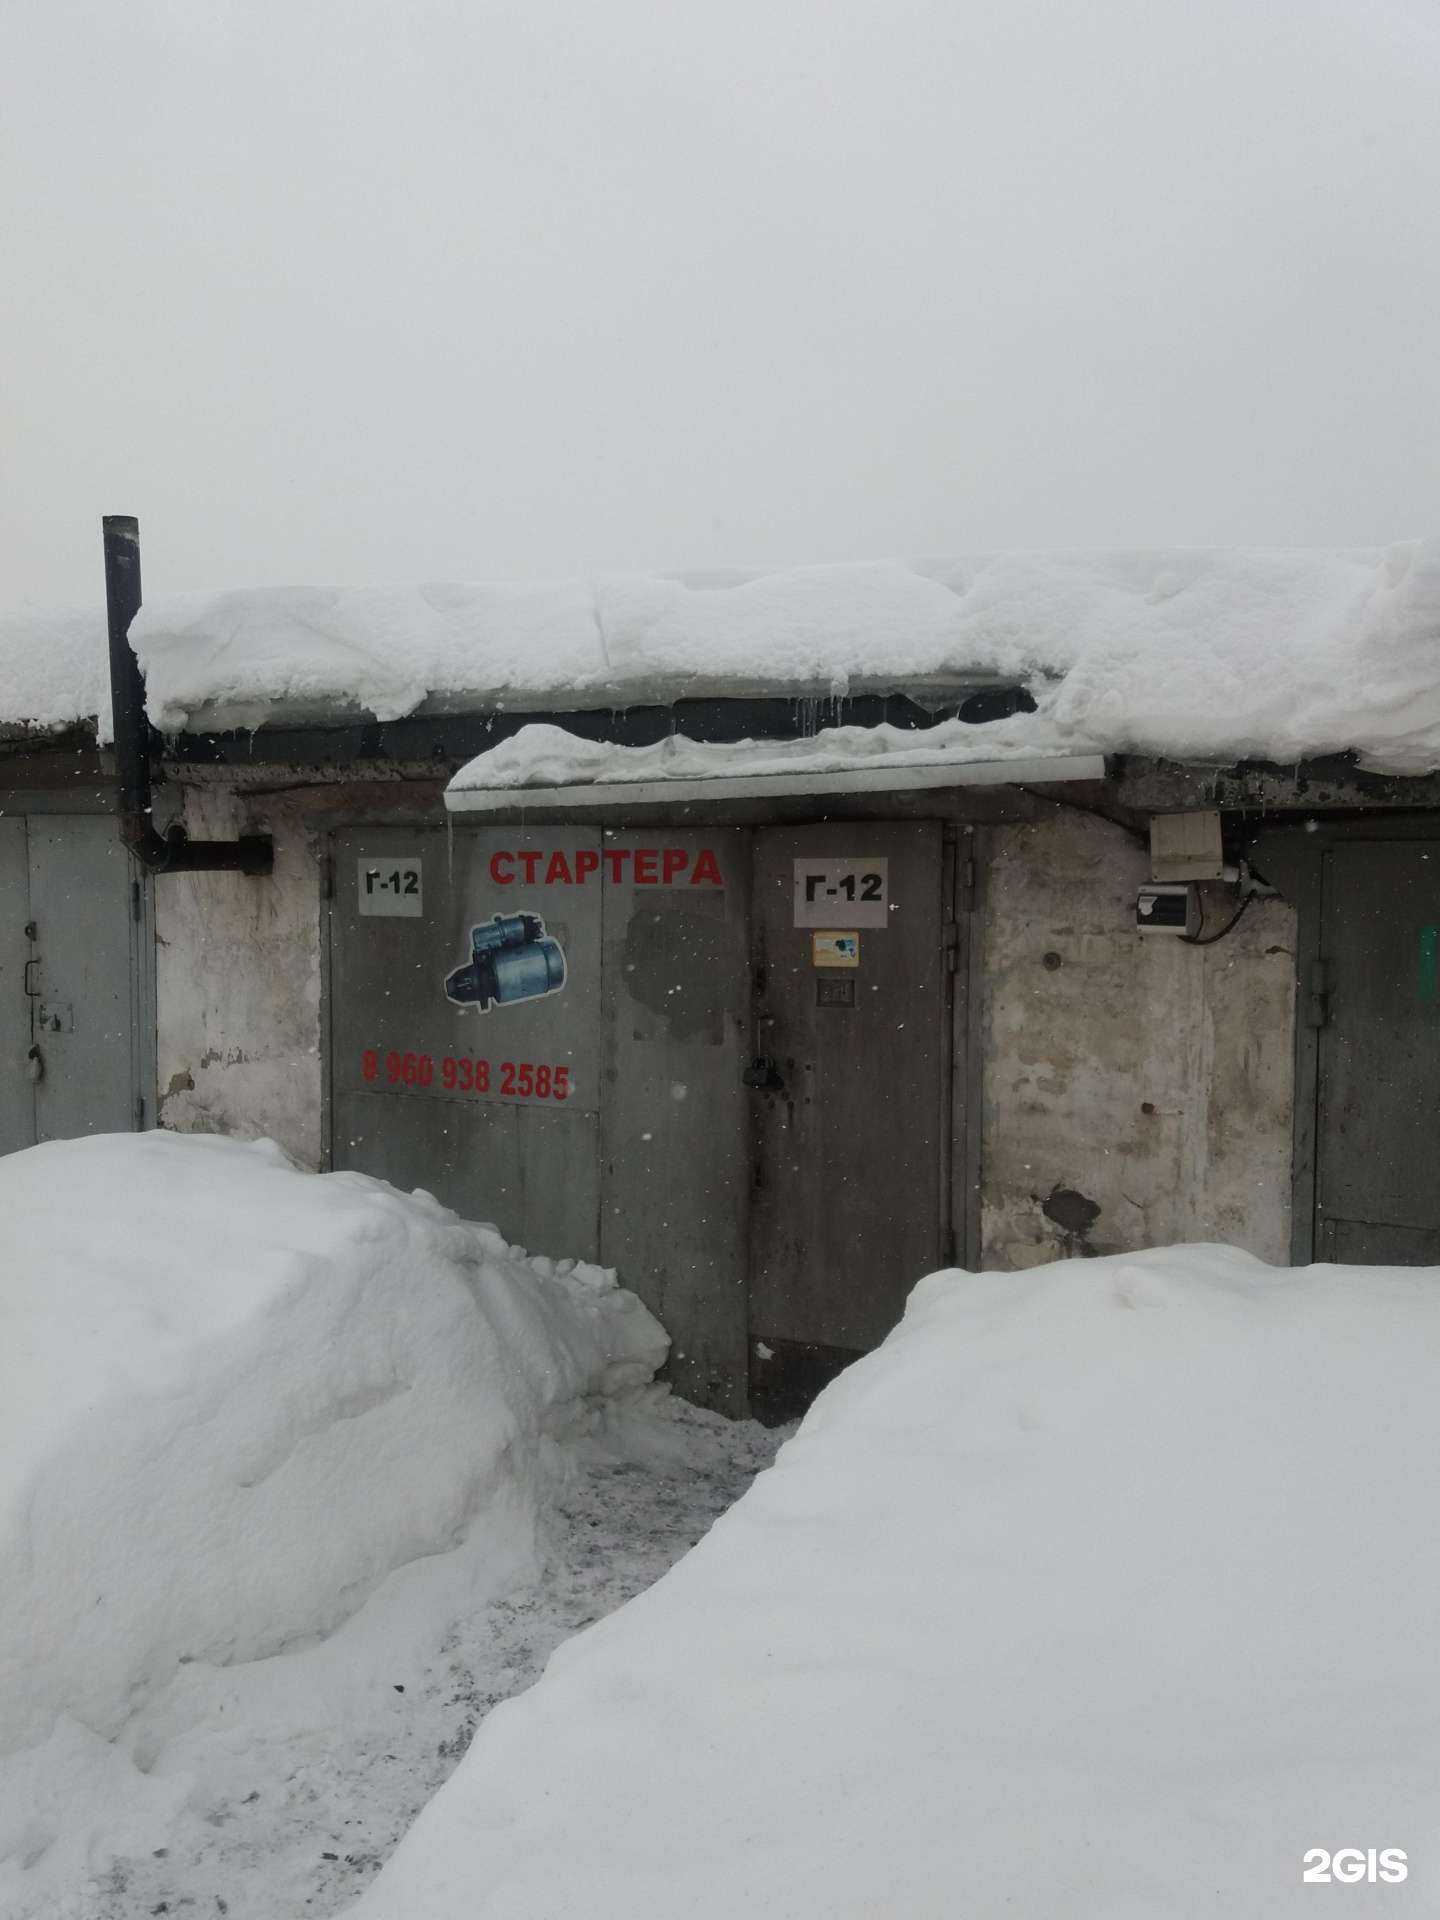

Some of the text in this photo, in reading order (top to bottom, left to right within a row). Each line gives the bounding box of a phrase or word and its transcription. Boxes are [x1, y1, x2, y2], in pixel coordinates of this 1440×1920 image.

[366, 871, 419, 895] Г-12
[490, 849, 723, 885] СТАРТЕРА
[806, 873, 882, 902] Г-12
[386, 1051, 433, 1088] 960
[442, 1056, 491, 1093] 938
[500, 1062, 571, 1100] 2585
